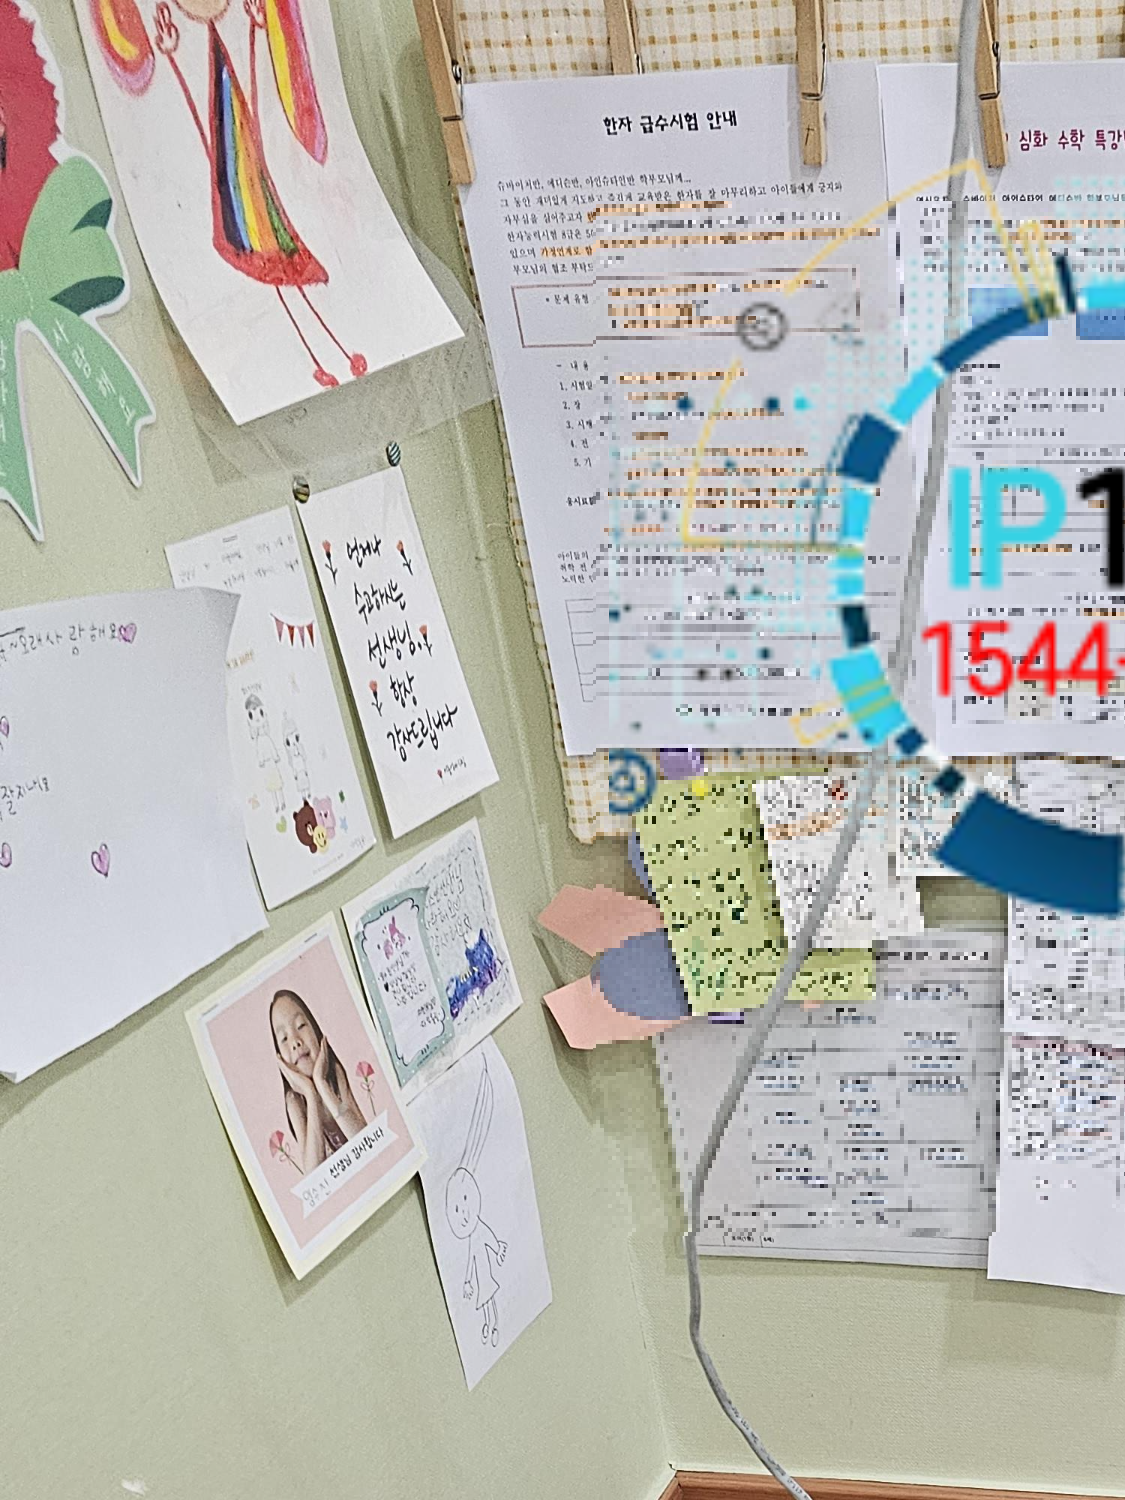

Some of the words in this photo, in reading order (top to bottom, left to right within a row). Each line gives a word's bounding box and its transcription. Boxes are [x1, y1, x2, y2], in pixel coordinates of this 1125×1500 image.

[603, 116, 632, 136] 한자
[640, 112, 699, 134] 급수시험
[706, 110, 737, 130] 안내
[1019, 129, 1048, 151] 심화
[1058, 129, 1085, 150] 수학
[346, 534, 381, 568] 언제나
[389, 670, 417, 708] 항상
[387, 703, 458, 762] 감사드립니다
[329, 1153, 352, 1179] 선생님
[351, 1126, 384, 1159] 감사합니다
